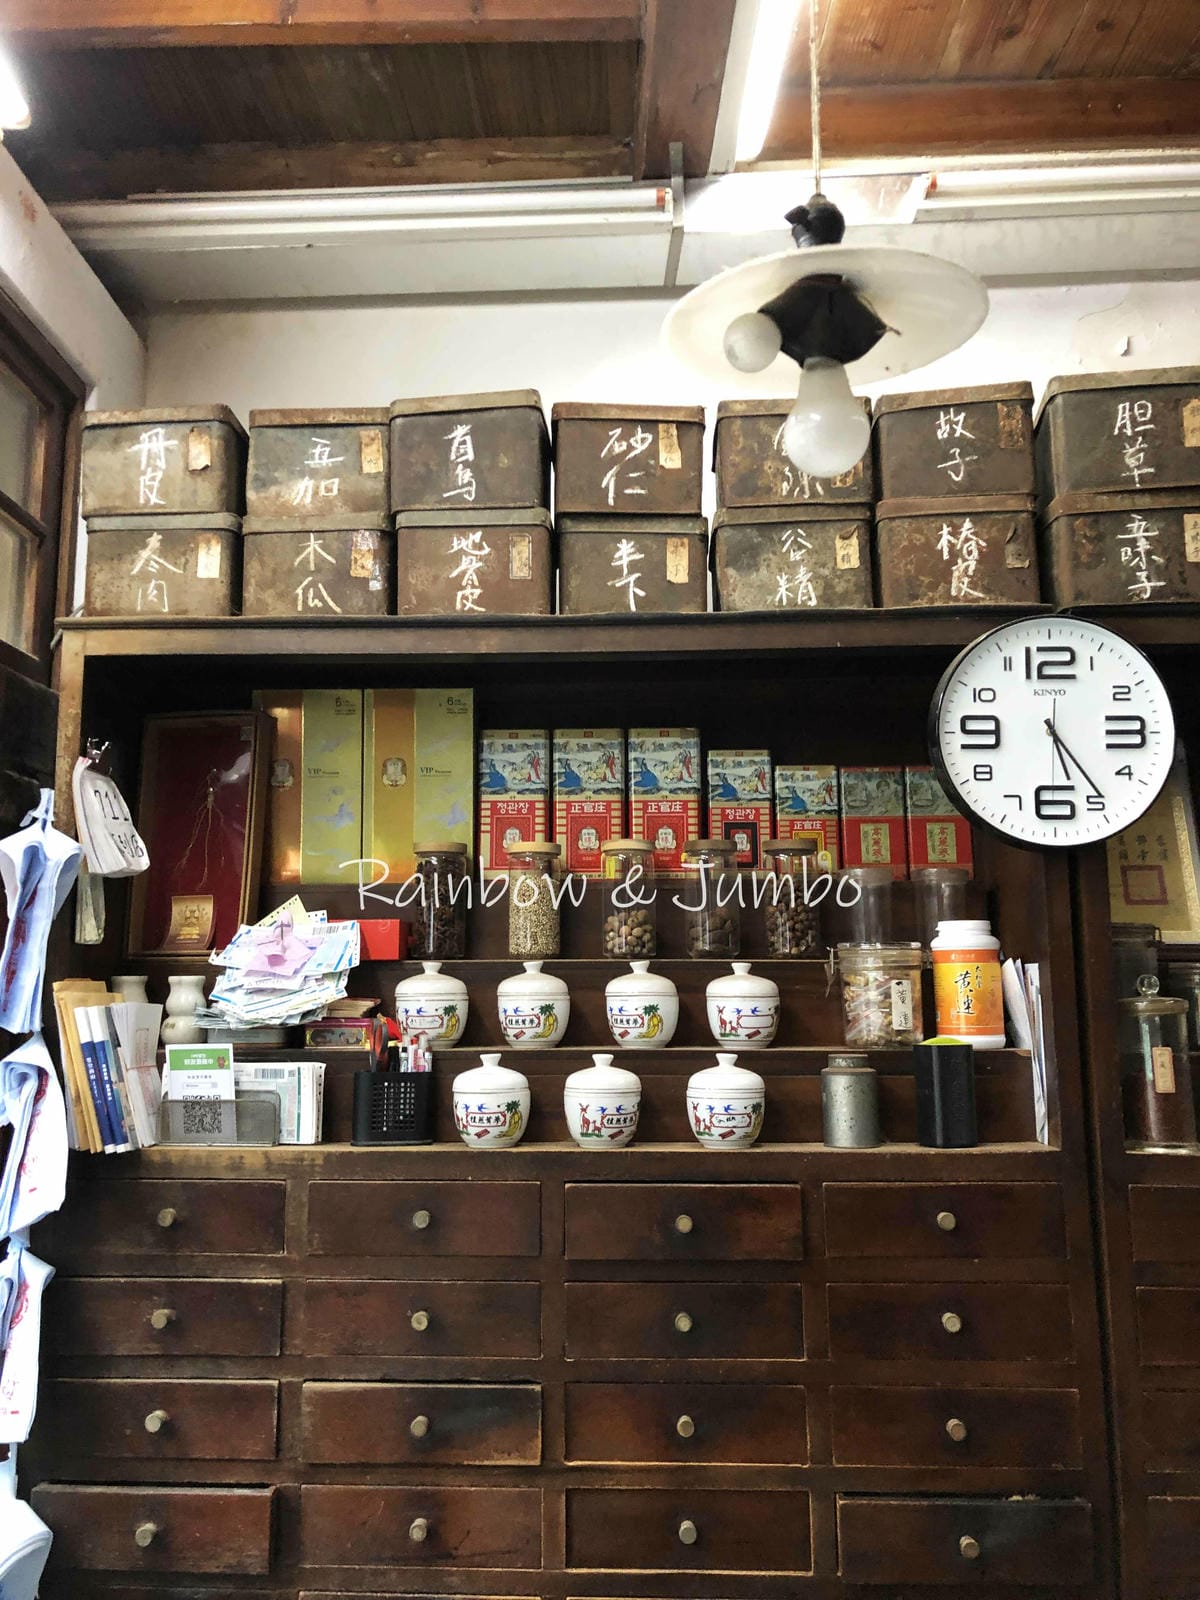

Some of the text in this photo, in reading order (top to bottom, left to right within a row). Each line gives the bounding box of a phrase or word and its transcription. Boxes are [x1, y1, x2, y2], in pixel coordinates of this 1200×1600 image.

[294, 532, 342, 614] 木瓜
[1025, 646, 1077, 680] 12
[973, 688, 996, 703] 10
[1033, 689, 1066, 697] KINYO
[1112, 685, 1131, 701] 2
[960, 715, 1000, 749] 9
[1105, 715, 1146, 749] 3
[973, 765, 993, 781] 8
[1114, 765, 1133, 781] 4
[497, 802, 529, 814] 정관장
[570, 801, 607, 813] 正官庄
[646, 801, 683, 813] 正官庄
[1003, 794, 1022, 811] 7
[1034, 785, 1076, 820] 6
[1086, 795, 1105, 811] 5
[725, 808, 756, 820] 정관장
[793, 820, 822, 830] 正官庄
